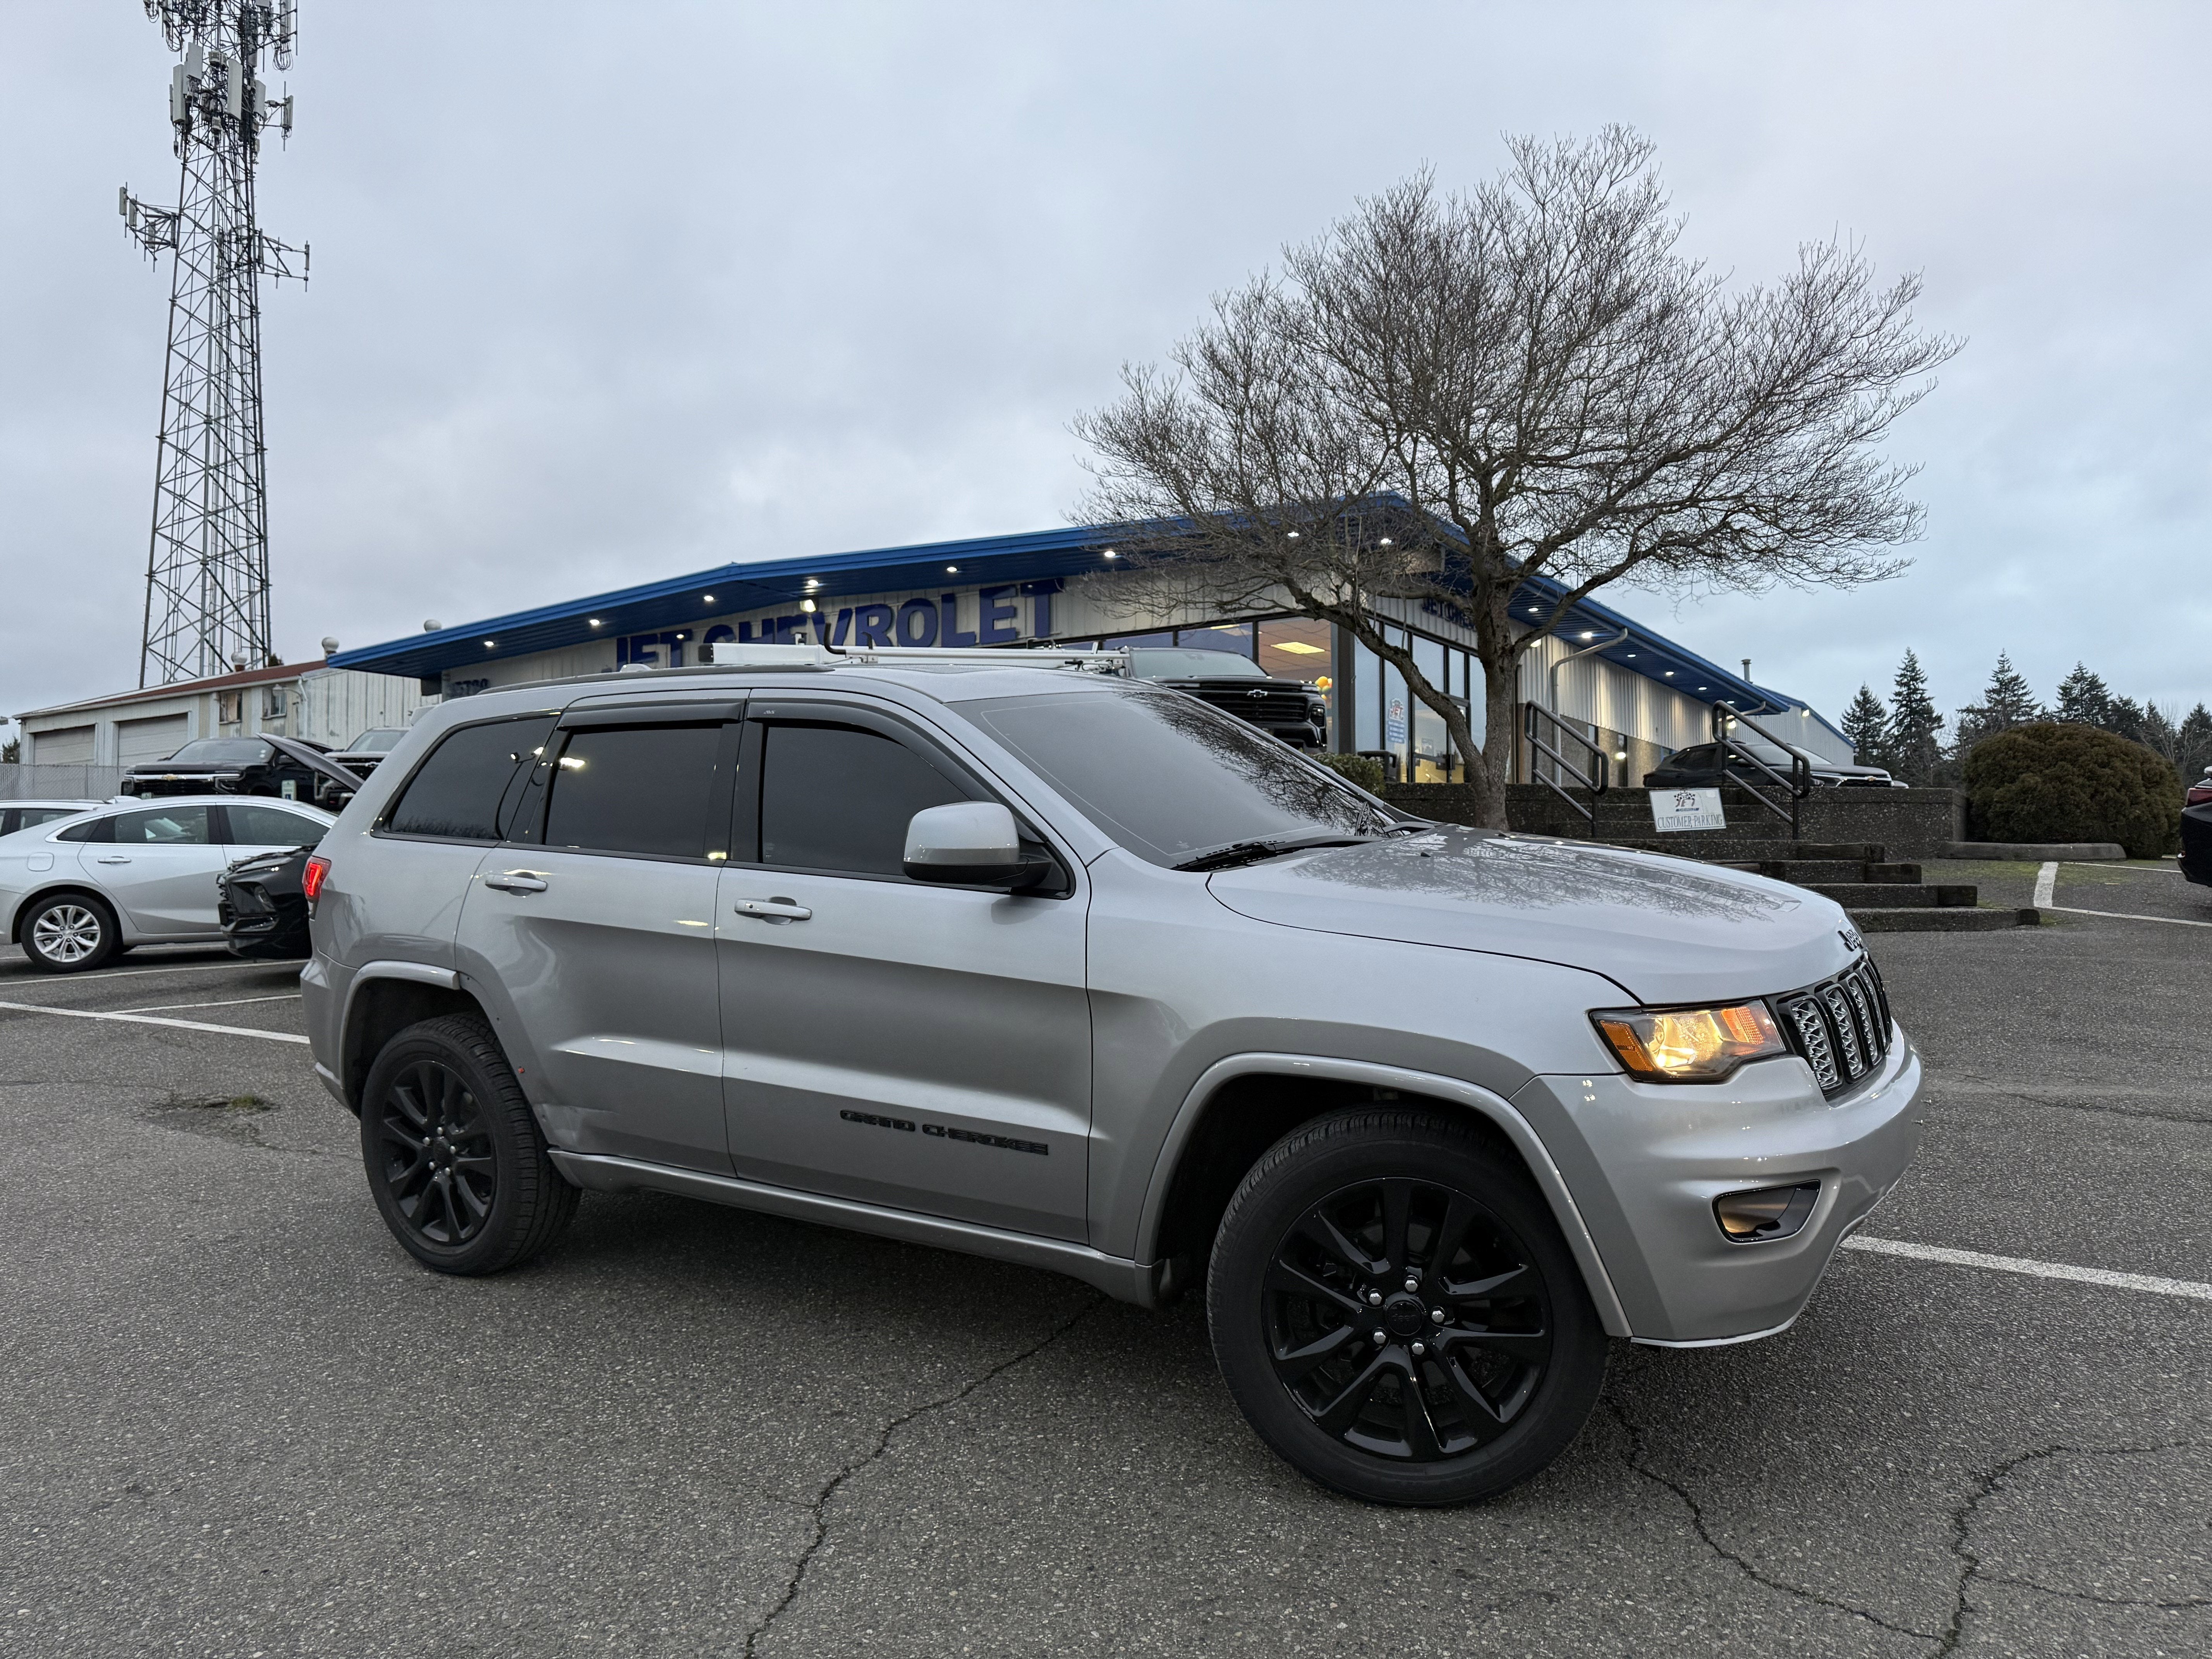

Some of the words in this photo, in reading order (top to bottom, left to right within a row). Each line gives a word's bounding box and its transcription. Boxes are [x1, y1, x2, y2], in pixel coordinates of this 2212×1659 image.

[1657, 816, 1692, 828] CUSTOMER
[1694, 814, 1723, 826] PARKING
[840, 1109, 915, 1132] GRAND
[922, 1124, 1048, 1155] CHEROKEE
